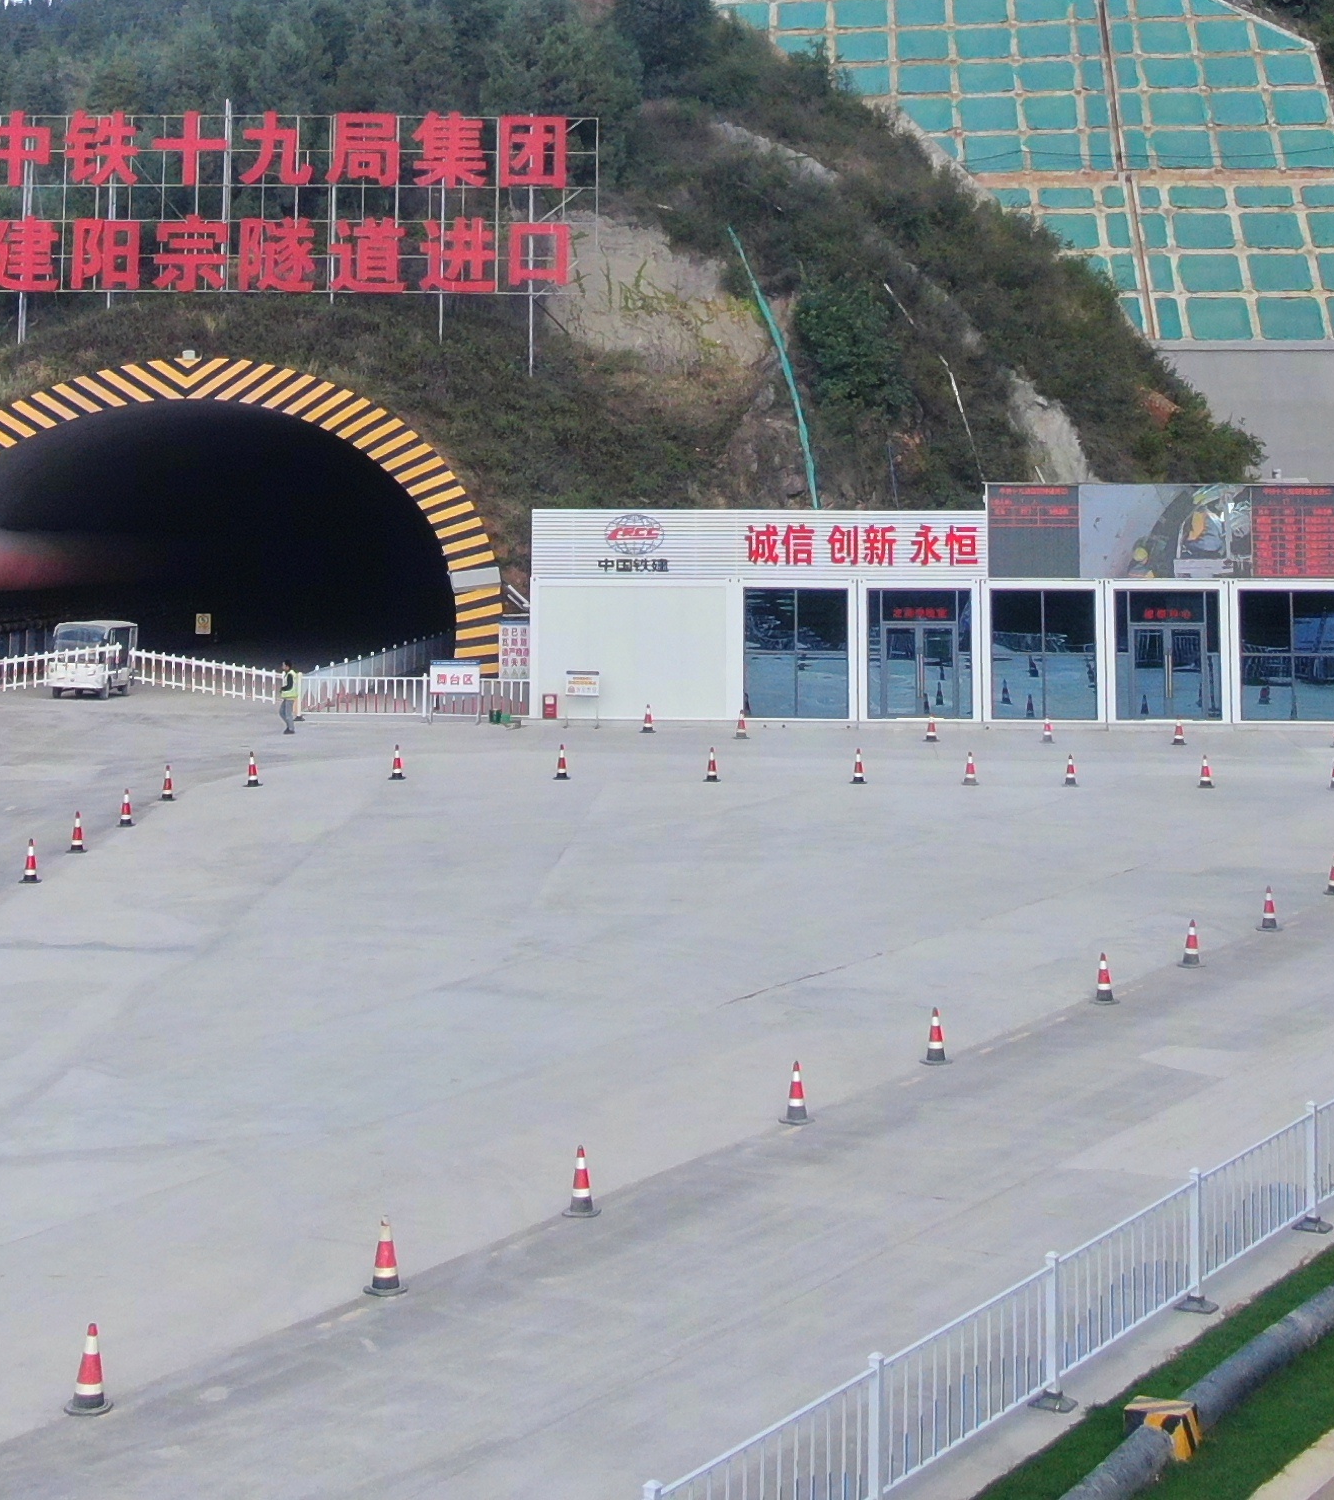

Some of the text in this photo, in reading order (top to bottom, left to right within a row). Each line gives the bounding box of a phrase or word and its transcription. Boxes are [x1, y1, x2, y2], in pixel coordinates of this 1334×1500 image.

[745, 524, 979, 566] 诚信 创新 永恒
[598, 558, 670, 572] 中国铁建
